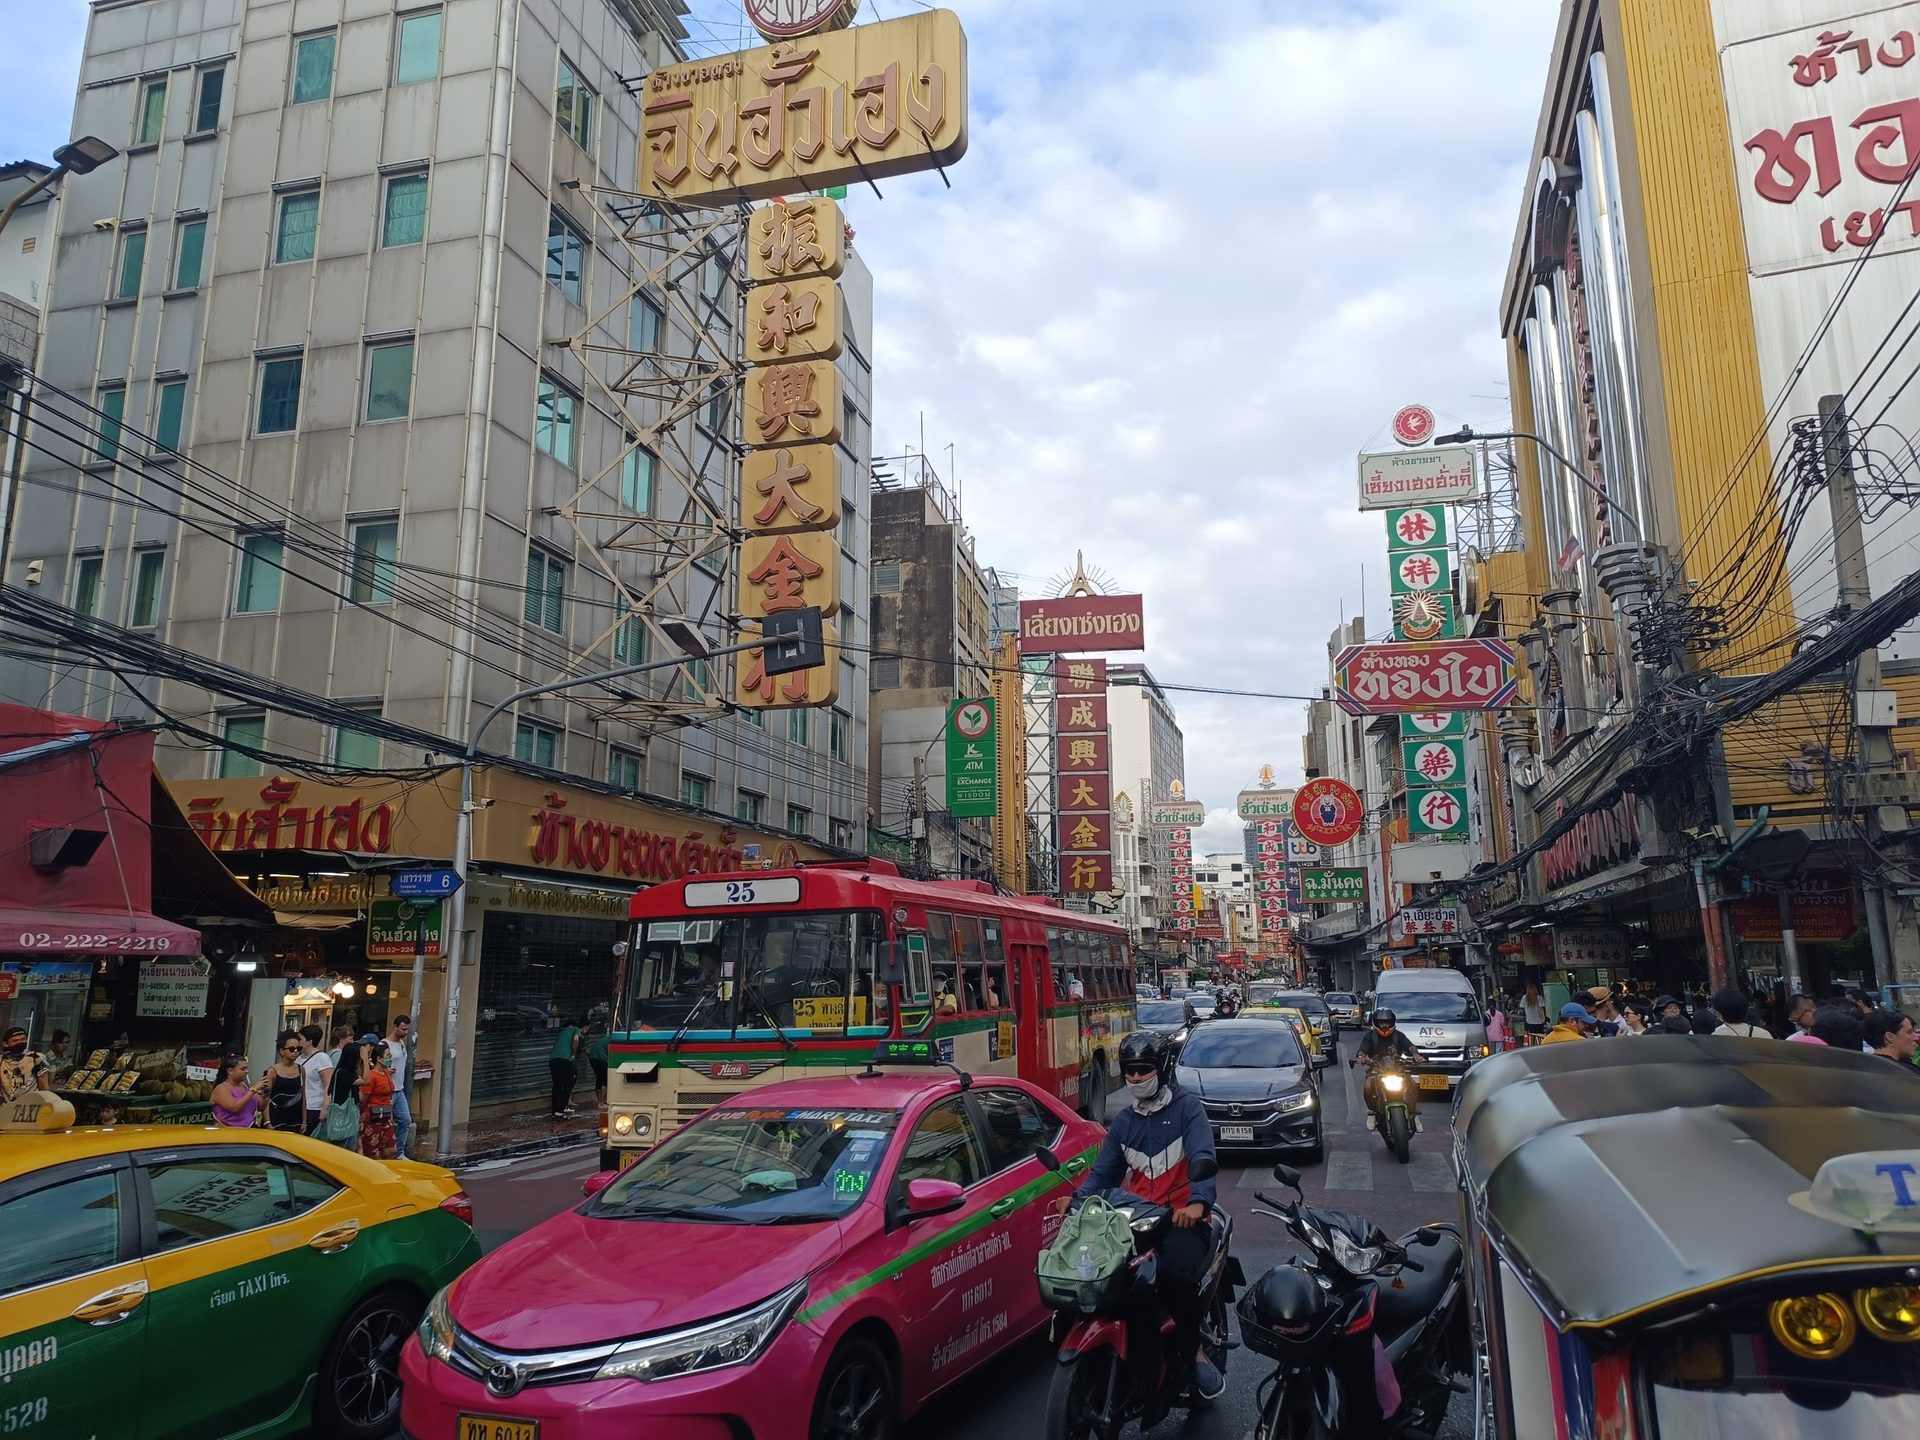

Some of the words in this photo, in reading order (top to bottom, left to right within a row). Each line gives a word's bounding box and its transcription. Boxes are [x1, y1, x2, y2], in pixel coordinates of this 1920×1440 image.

[1788, 31, 1920, 87] ห้าง
[651, 59, 743, 92] ห้างขายทอง
[644, 43, 946, 187] จินฮั้วเฮง
[1024, 608, 1140, 637] เลี่ยงเซ่งเฮง
[1361, 652, 1429, 669] ห้างทอง
[1354, 652, 1496, 700] ทองใบ
[965, 762, 983, 770] ATM
[1068, 663, 1101, 889] 聯成興大金行
[1291, 842, 1317, 854] ttb
[400, 874, 432, 883] เยาวราช
[442, 875, 450, 888] 6
[1305, 870, 1363, 889] ฉ.มั่นคง
[726, 883, 755, 903] 25
[20, 932, 170, 950] 02-222-2219
[793, 1000, 815, 1017] 25
[1420, 1027, 1444, 1035] ATC
[717, 1064, 741, 1075] Hino
[12, 1104, 41, 1122] TAXI
[786, 1111, 839, 1121] SMART
[844, 1112, 887, 1123] TAXI
[210, 1289, 236, 1309] เรียก
[238, 1275, 267, 1300] TAXI
[269, 1271, 290, 1288] โทร.
[974, 1277, 993, 1305] 6013
[0, 1396, 48, 1433] 528
